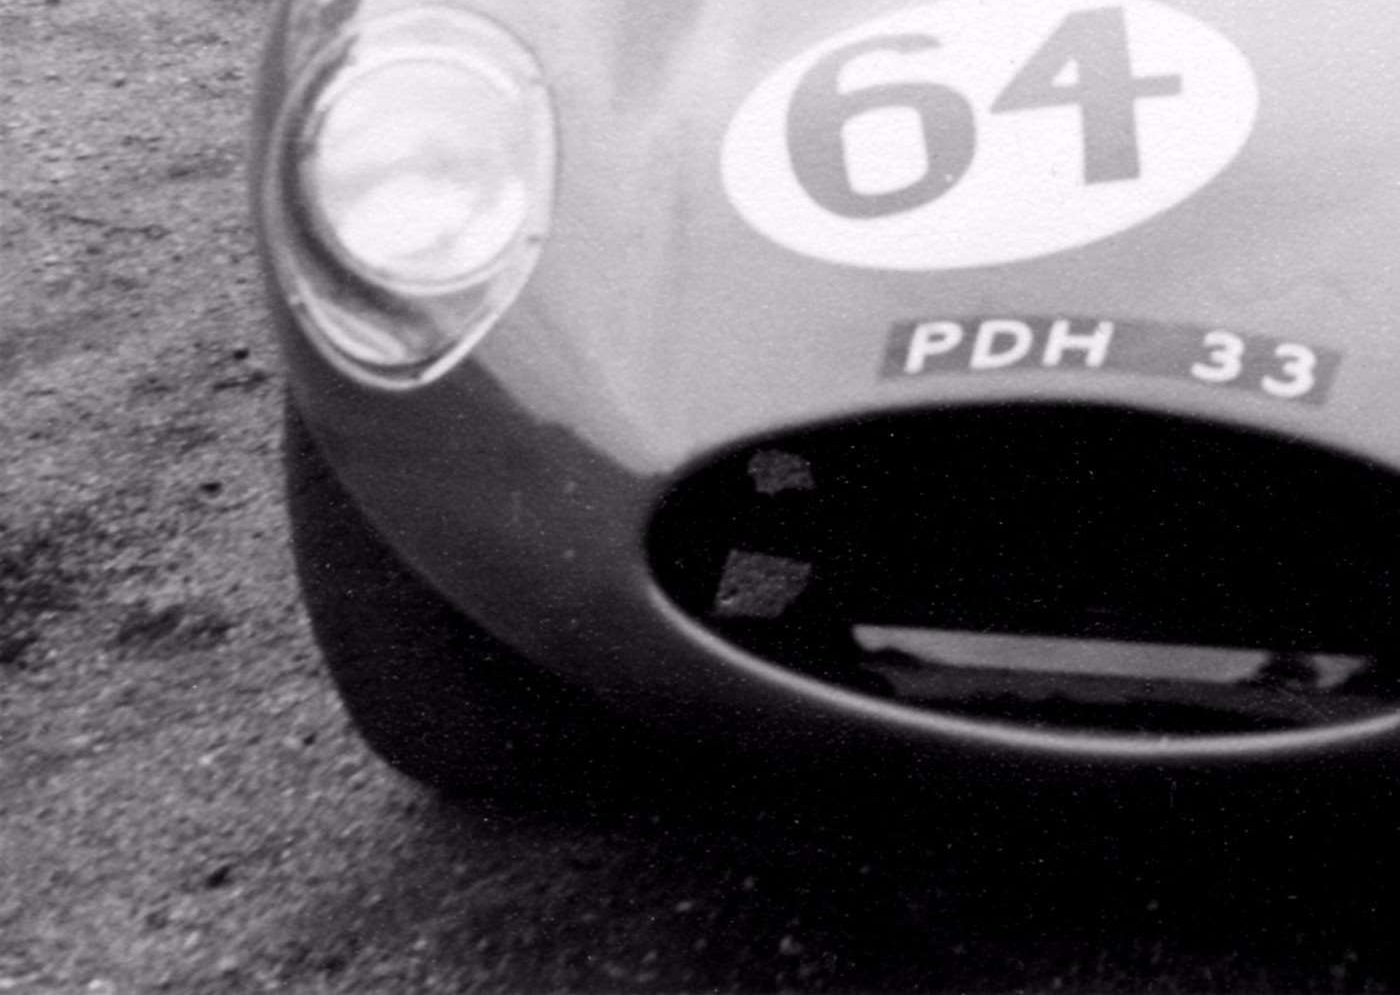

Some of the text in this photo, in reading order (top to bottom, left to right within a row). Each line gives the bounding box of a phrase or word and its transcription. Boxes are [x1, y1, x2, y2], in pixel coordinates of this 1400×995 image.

[785, 5, 1183, 221] 64
[903, 319, 1318, 398] PDH 33
